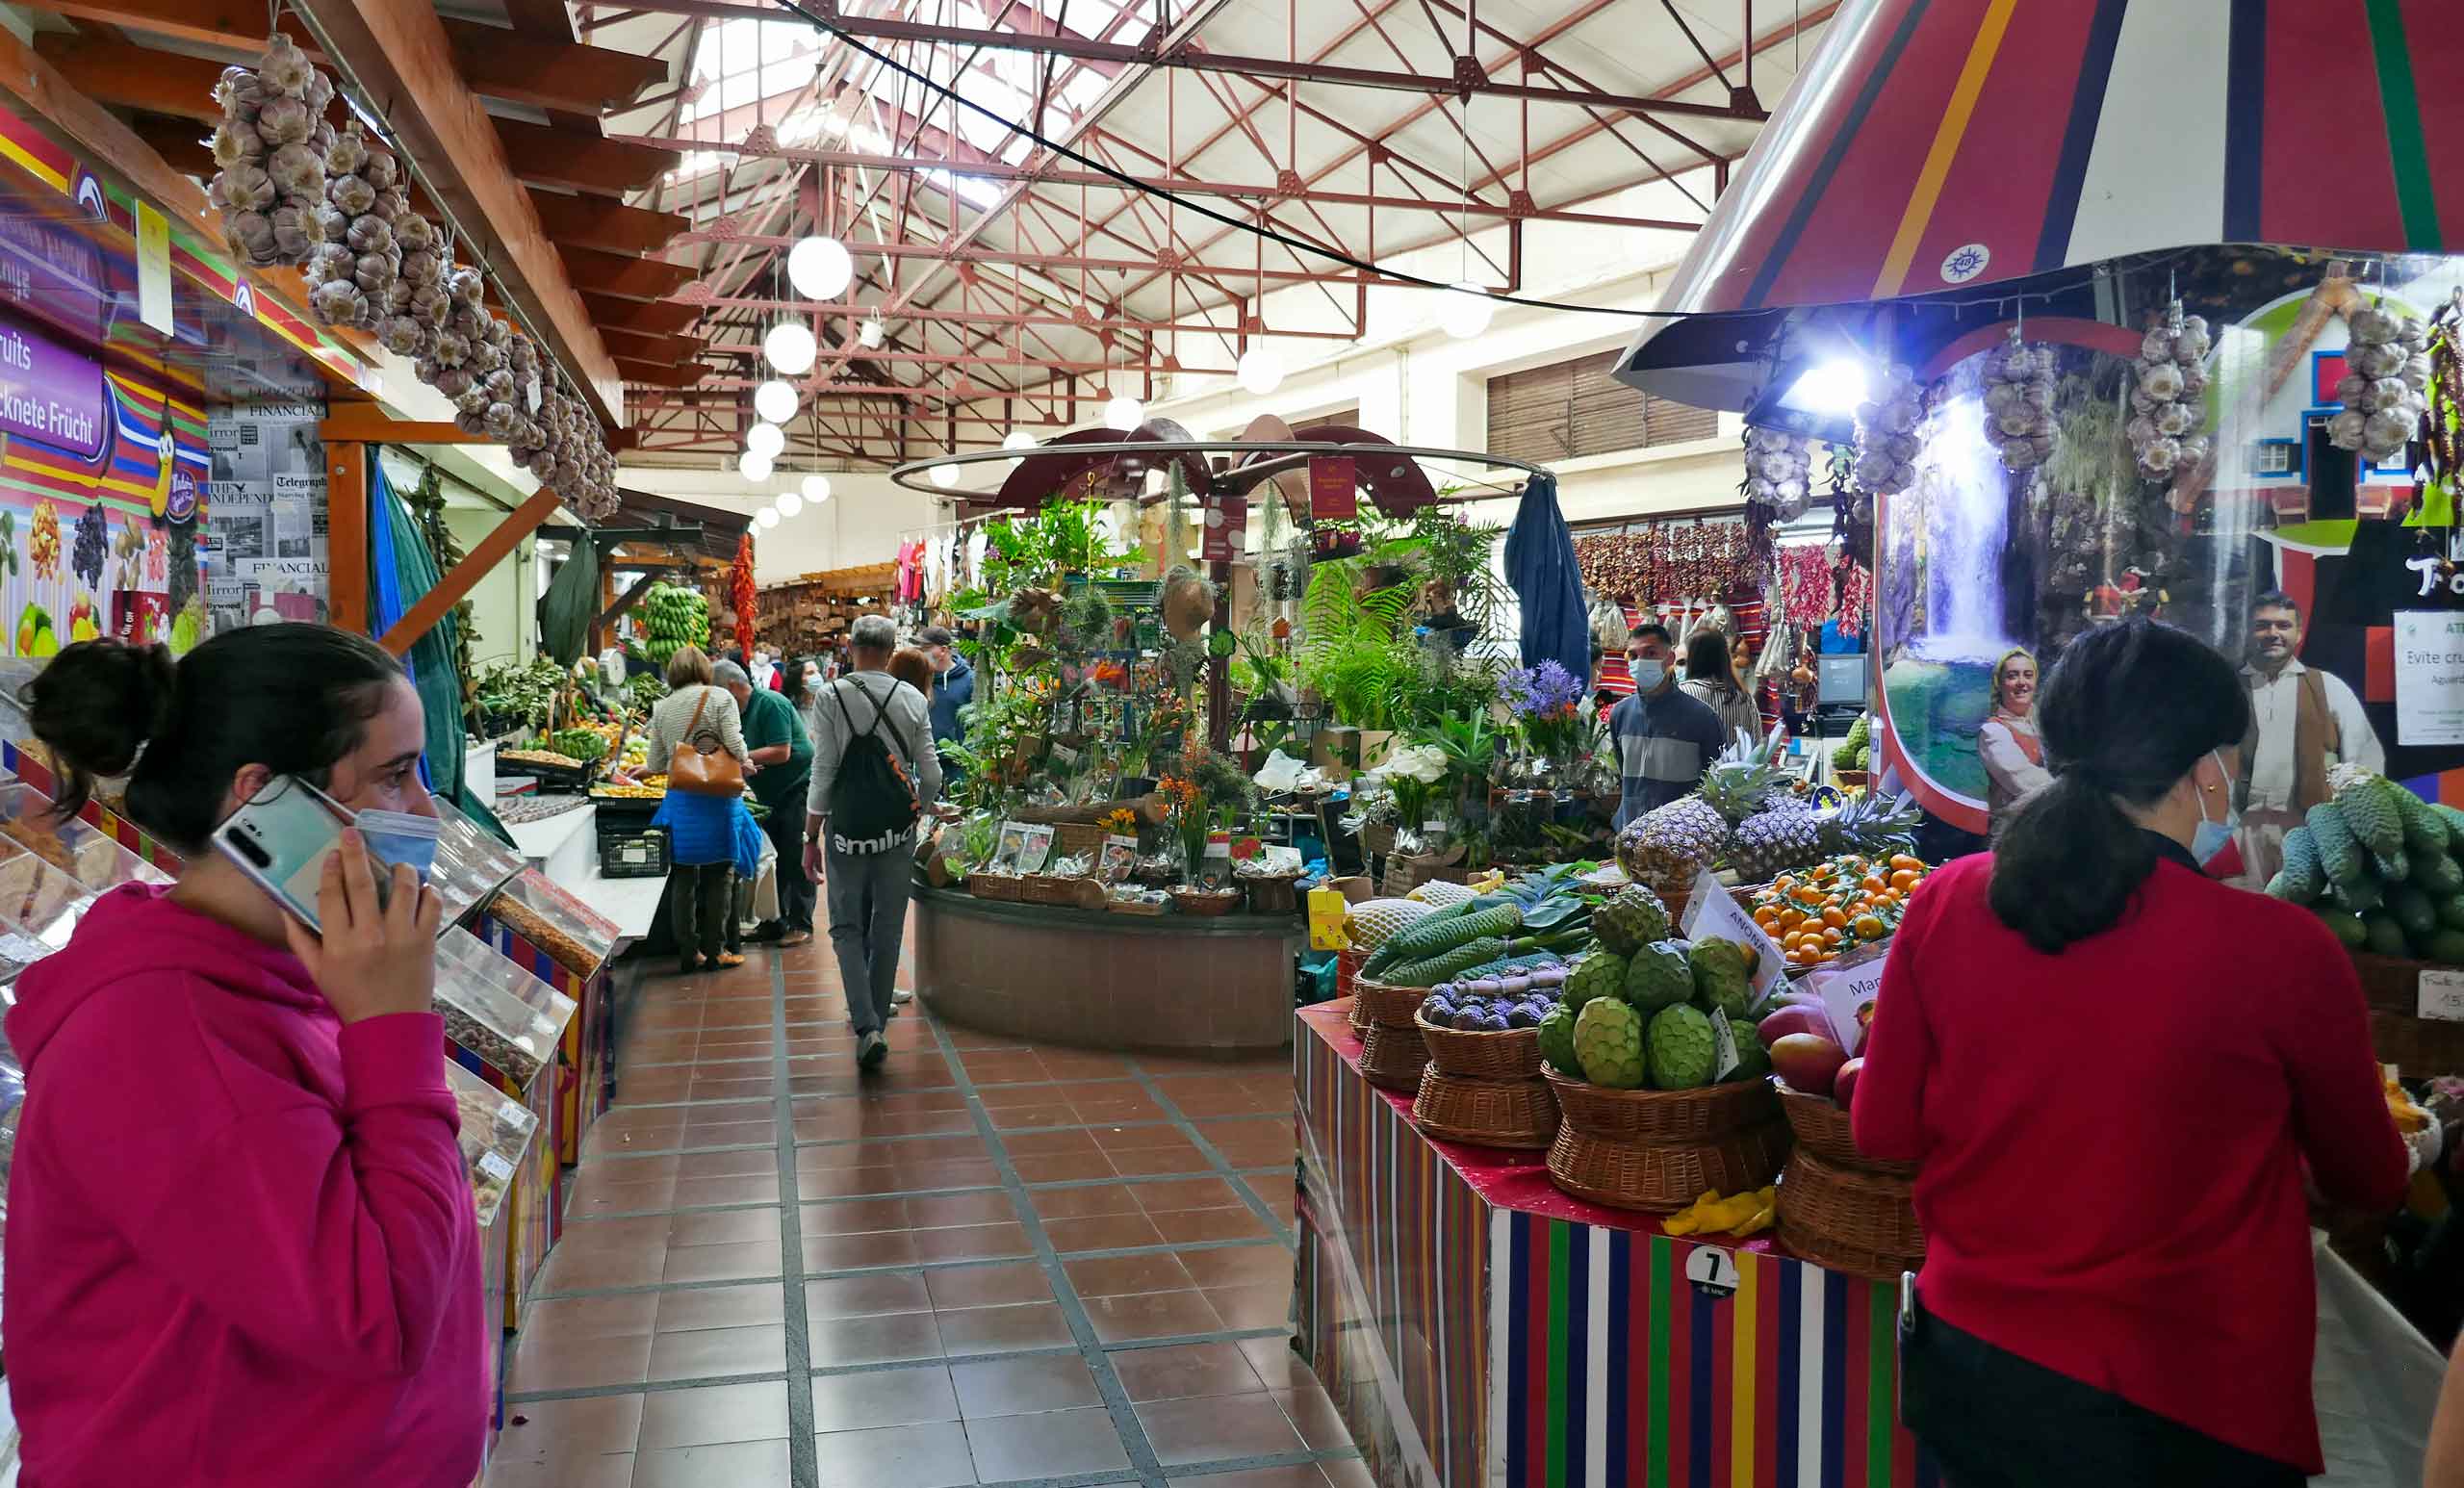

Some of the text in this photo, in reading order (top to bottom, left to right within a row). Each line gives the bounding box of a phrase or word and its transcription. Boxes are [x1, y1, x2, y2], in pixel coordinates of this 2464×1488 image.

[0, 331, 31, 371] uits
[2406, 650, 2441, 664] Evite
[1730, 911, 1767, 956] ANONA
[1706, 1252, 1720, 1281] 7
